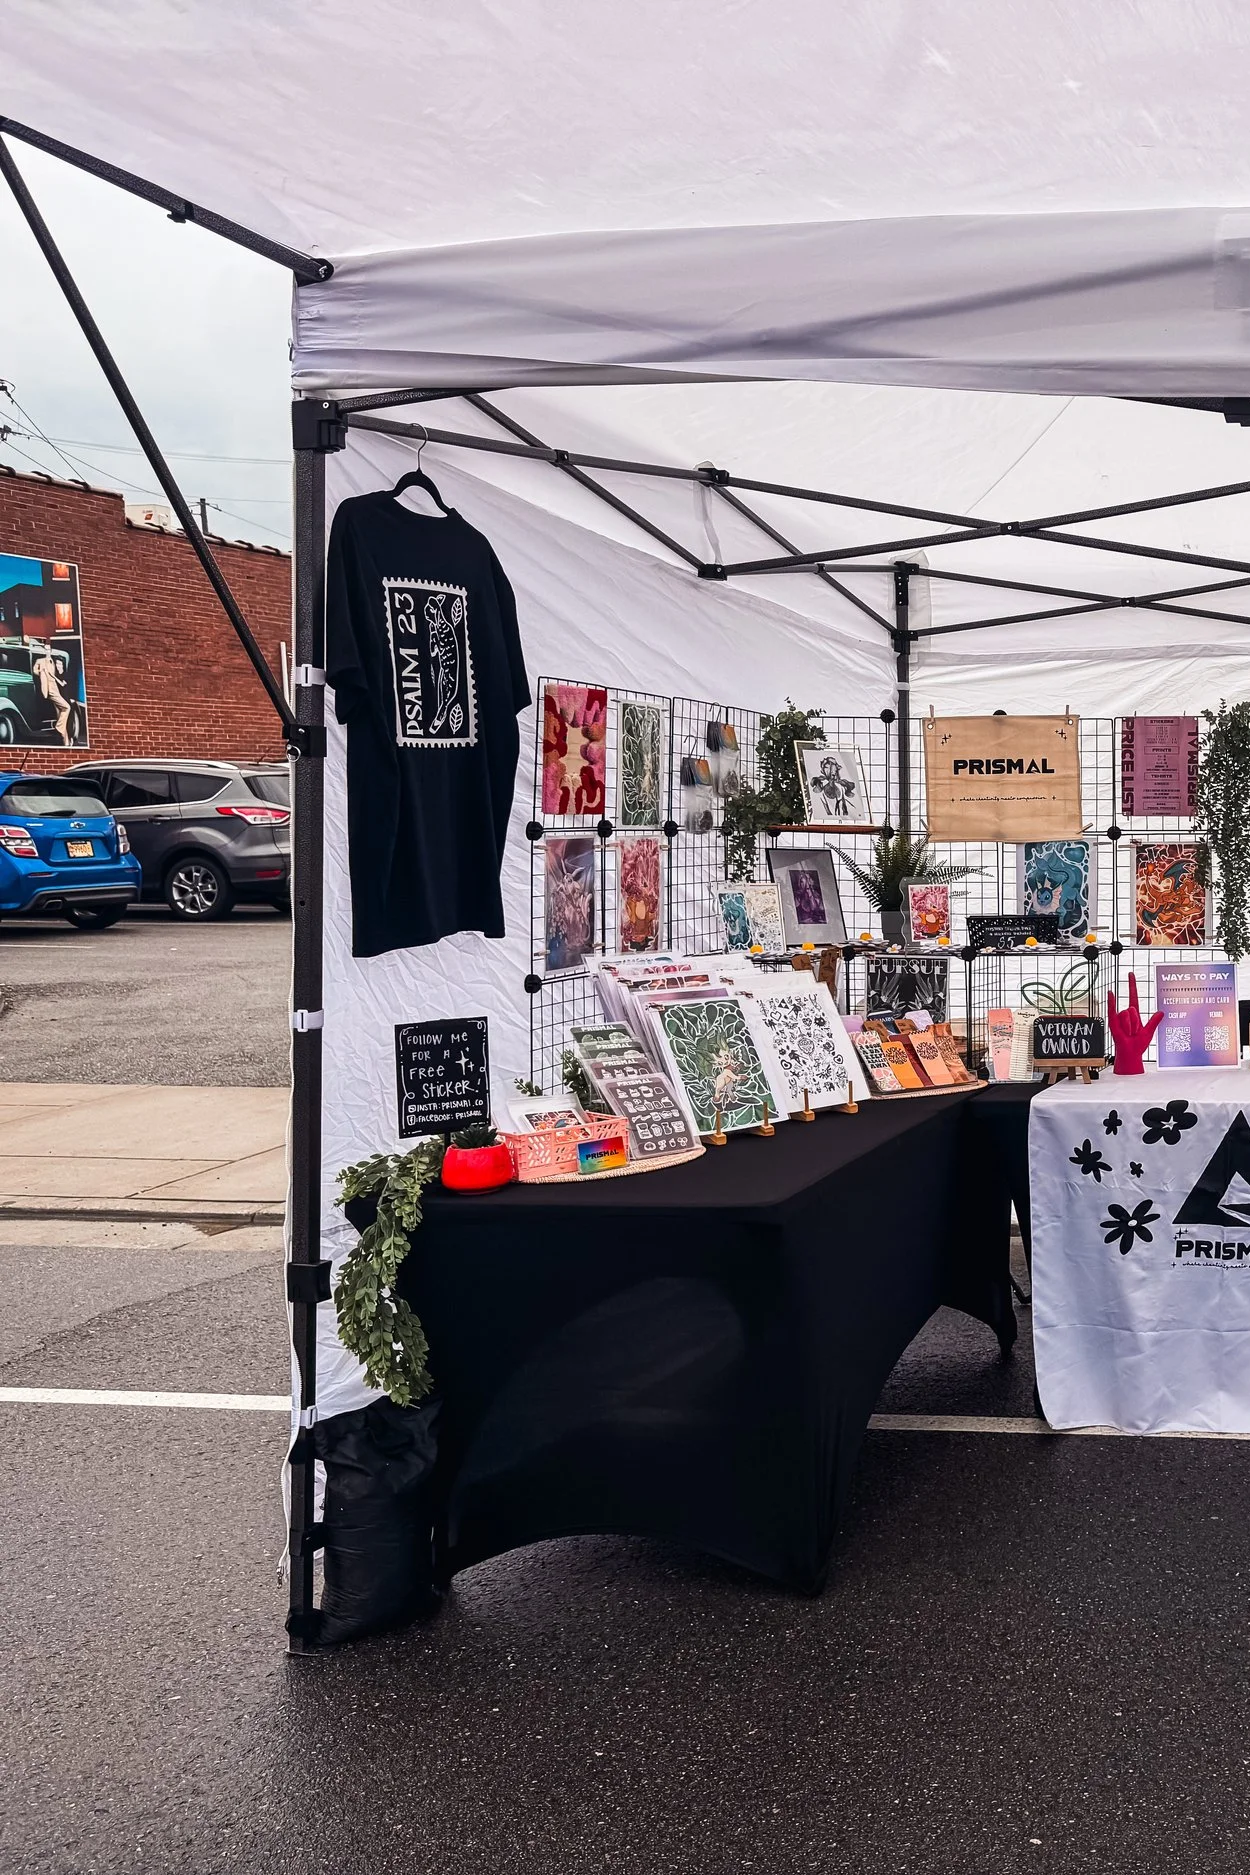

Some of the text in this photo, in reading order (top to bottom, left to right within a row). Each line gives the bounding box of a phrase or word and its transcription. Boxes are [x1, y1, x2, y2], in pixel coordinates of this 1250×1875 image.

[394, 592, 424, 736] PSALM 23
[953, 758, 1055, 775] PRISMAL
[1122, 717, 1134, 816] PRICE LIST
[1187, 725, 1198, 806] PRISMAL
[867, 958, 947, 975] PURSUE
[1161, 973, 1191, 981] WAYS
[1209, 972, 1230, 980] PAY
[1163, 997, 1190, 1005] ACCEPTING
[1205, 996, 1216, 1004] AND
[1217, 996, 1230, 1004] CARD
[1038, 1022, 1094, 1037] VETERAN
[1041, 1037, 1090, 1055] OWNED
[412, 1049, 450, 1061] FOR A
[602, 1058, 639, 1067] PRISMAL
[616, 1078, 653, 1087] PRISMAL
[585, 1149, 619, 1160] PRISMAL
